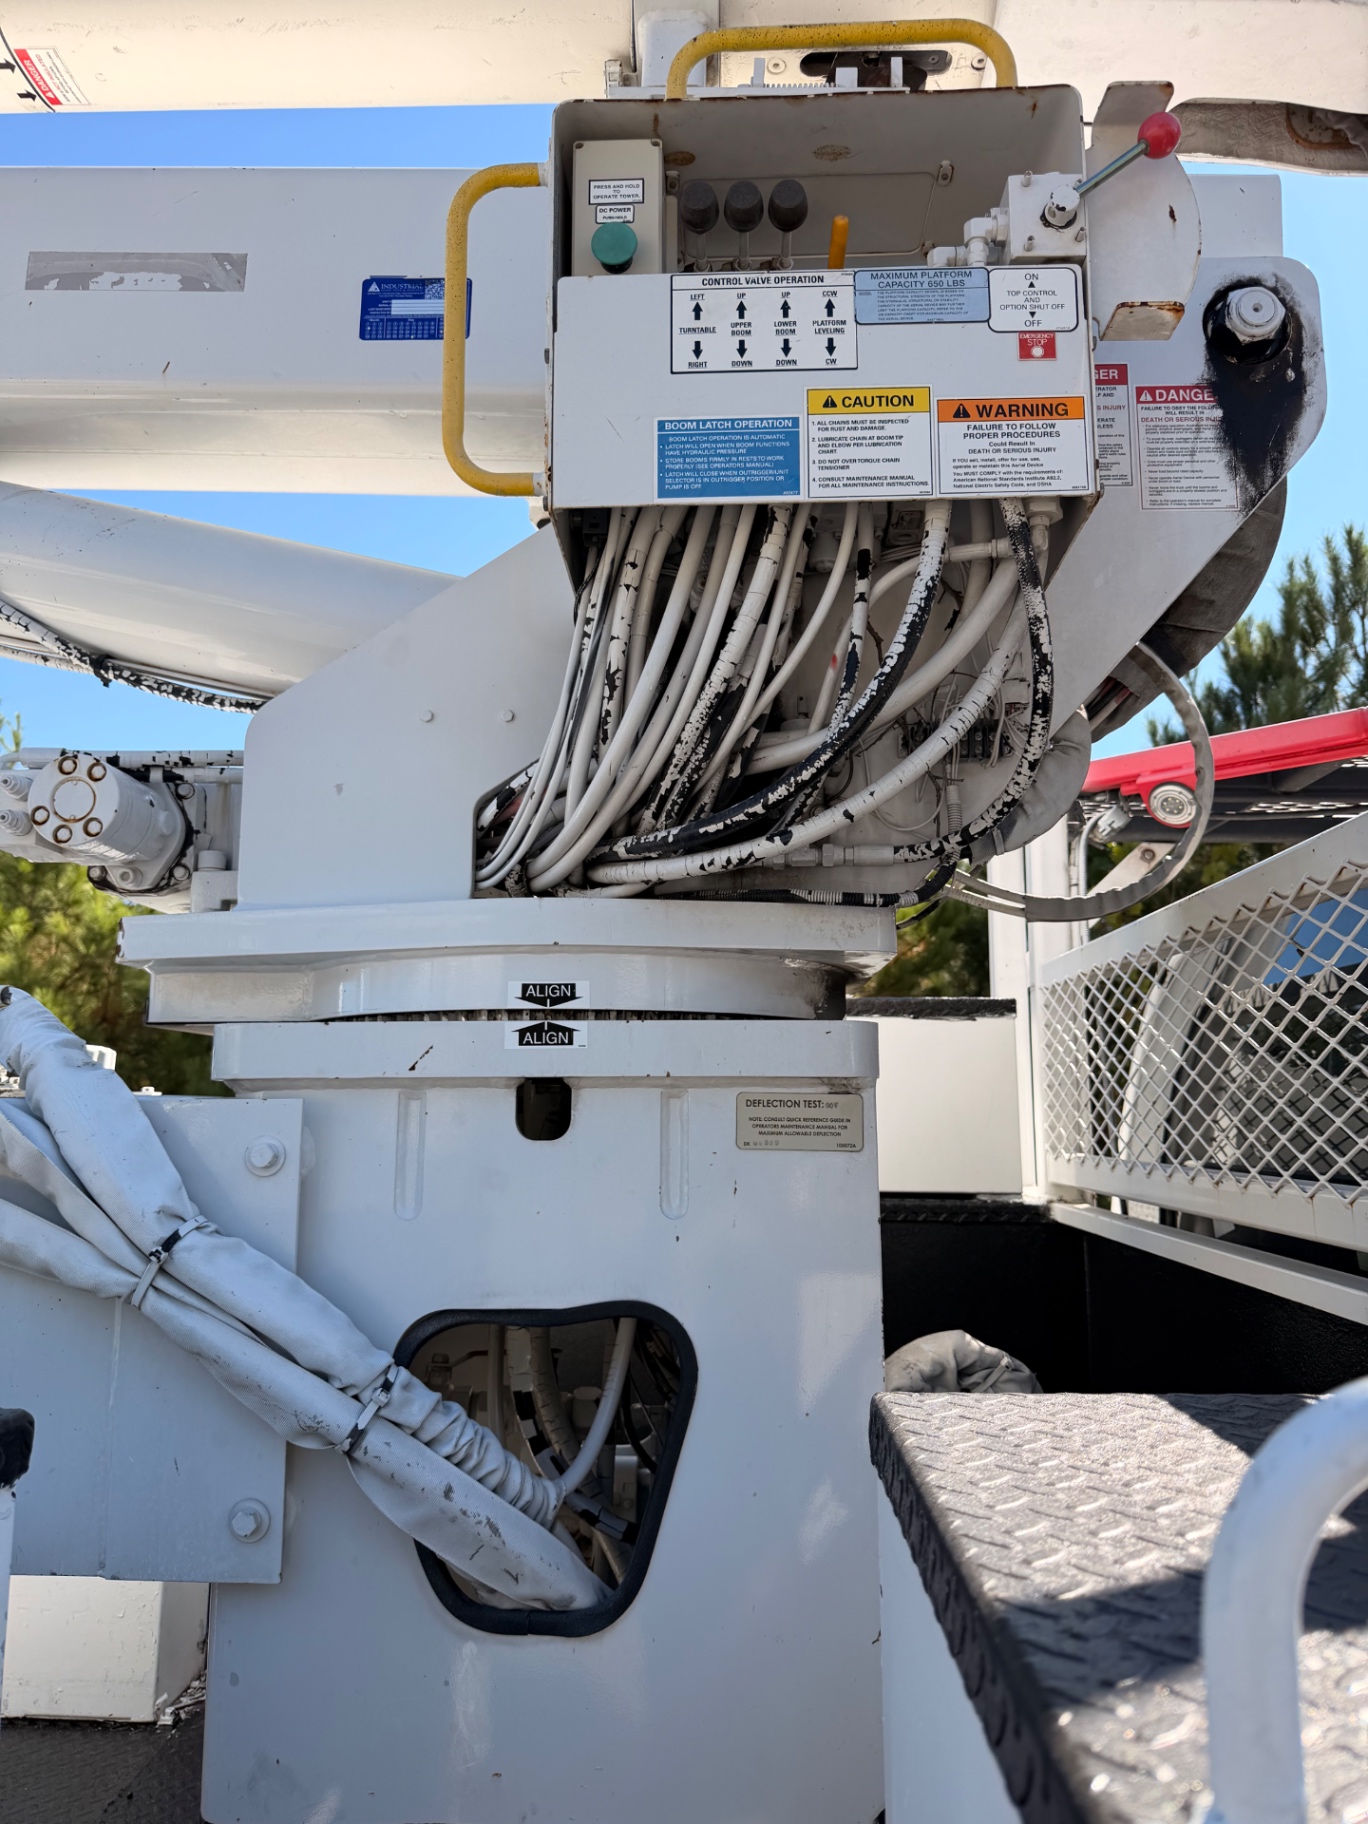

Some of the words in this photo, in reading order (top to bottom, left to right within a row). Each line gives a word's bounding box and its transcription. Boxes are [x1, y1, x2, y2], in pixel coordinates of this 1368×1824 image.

[24, 60, 49, 91] DANGER
[702, 278, 743, 286] CONTROL
[745, 277, 772, 285] VALVE
[774, 275, 824, 284] OPERATION
[871, 272, 918, 280] MAXIMUM
[921, 271, 972, 279] PLATFORM
[842, 394, 914, 408] CAUTION
[1156, 389, 1218, 401] DANGE
[976, 402, 1068, 418] WARNING
[665, 422, 696, 430] BOOM
[700, 421, 731, 429] LATCH
[734, 420, 792, 428] OPERATION
[526, 985, 571, 997] ALIGN
[523, 1032, 568, 1044] ALIGN
[746, 1099, 800, 1108] DEFLECTION
[804, 1100, 825, 1108] TEST:
